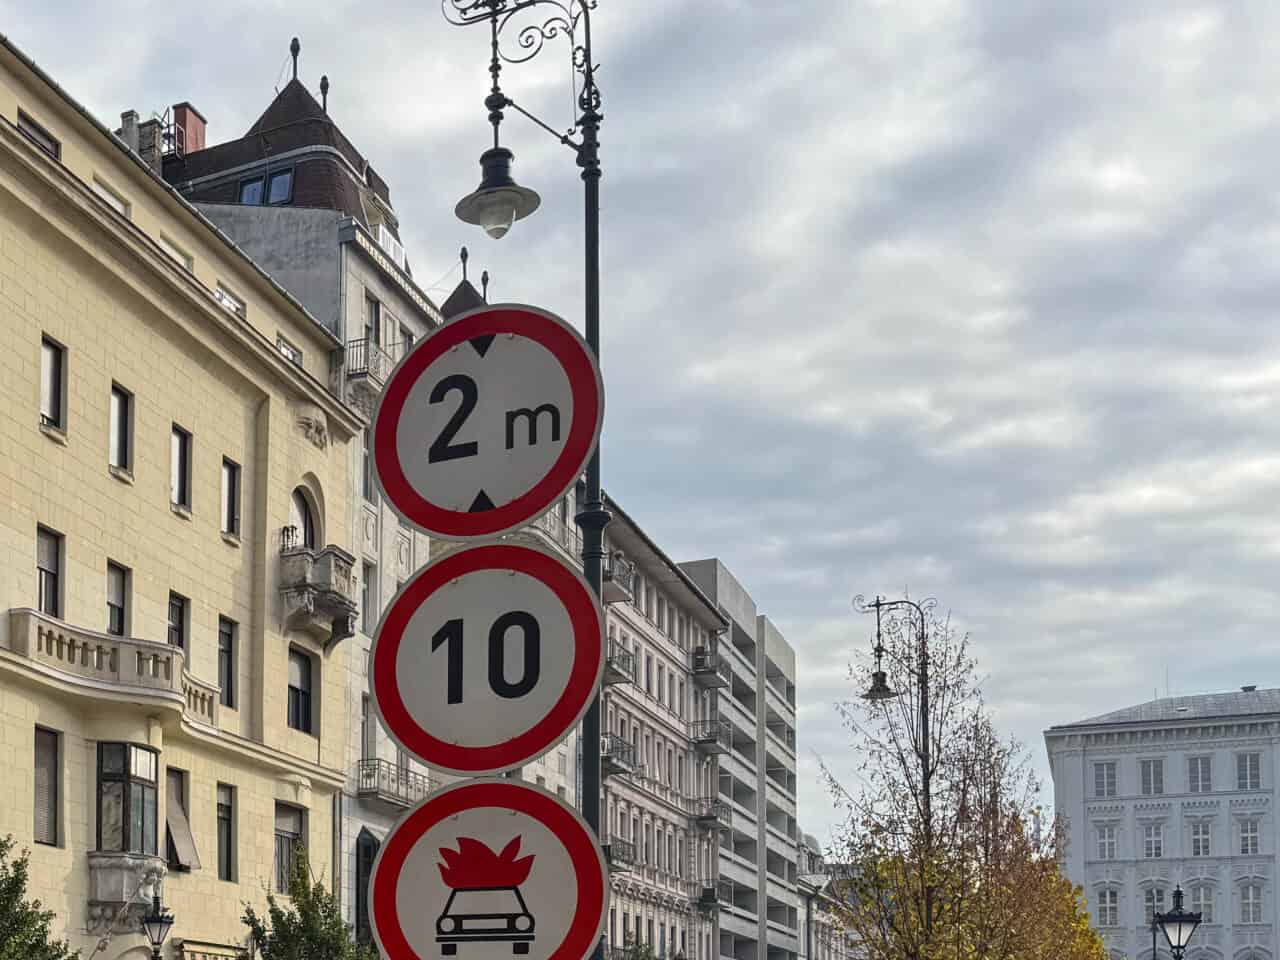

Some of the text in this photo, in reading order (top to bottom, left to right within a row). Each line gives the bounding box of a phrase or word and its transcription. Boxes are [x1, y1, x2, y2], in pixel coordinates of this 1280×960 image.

[428, 374, 561, 464] 2 m
[431, 610, 541, 705] 10
